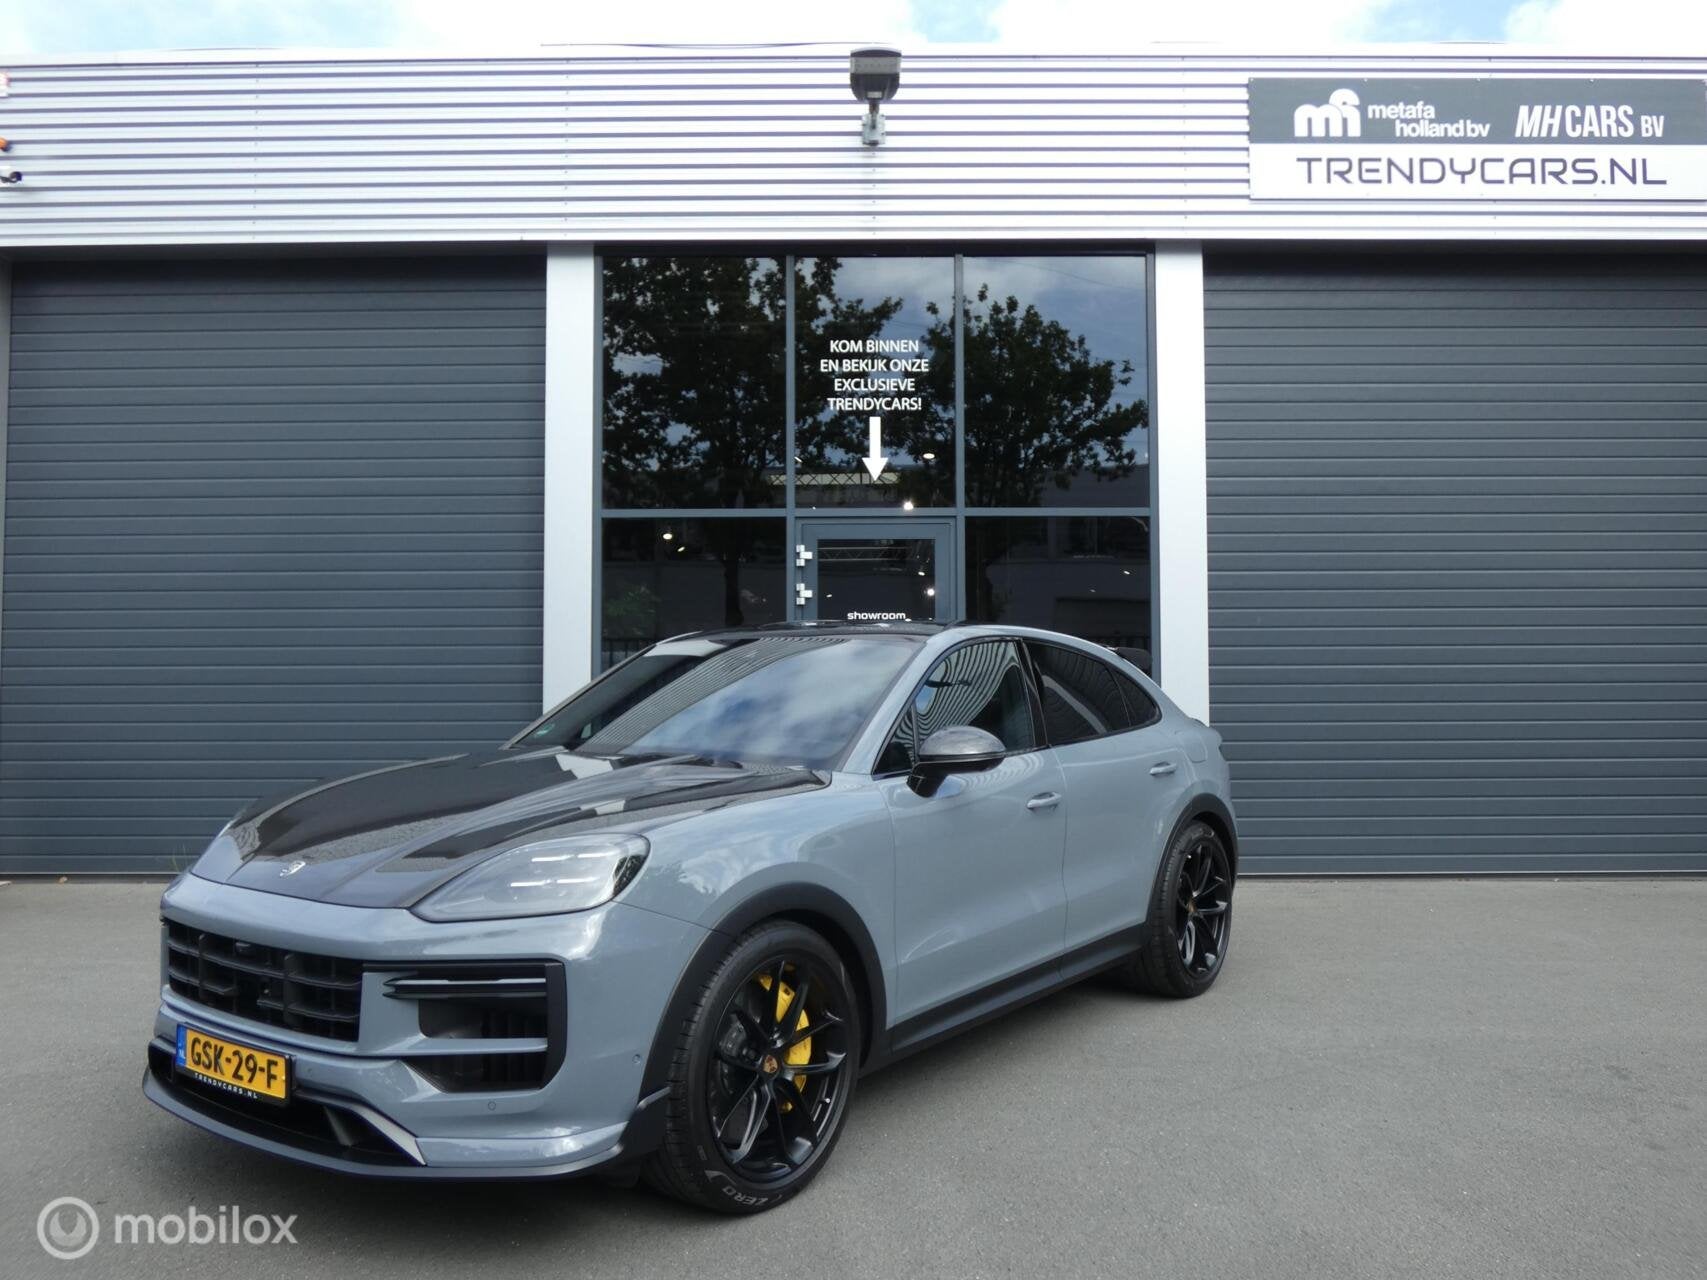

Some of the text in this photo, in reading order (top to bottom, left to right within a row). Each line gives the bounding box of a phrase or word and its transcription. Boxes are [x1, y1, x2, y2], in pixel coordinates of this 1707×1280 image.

[1367, 101, 1436, 119] metafa
[1641, 115, 1665, 138] BV
[1296, 157, 1667, 185] TRENDYCARS.NL
[829, 339, 919, 353] KOM BINNEN
[820, 359, 929, 372] EN BEKIJK ONZE
[834, 378, 915, 391] EXCLUSIEVE
[827, 397, 922, 411] TRENDYCARS!
[847, 611, 906, 620] showroom
[190, 1036, 279, 1090] GSK-29-F
[194, 1072, 258, 1099] TRENDYCARS.NL
